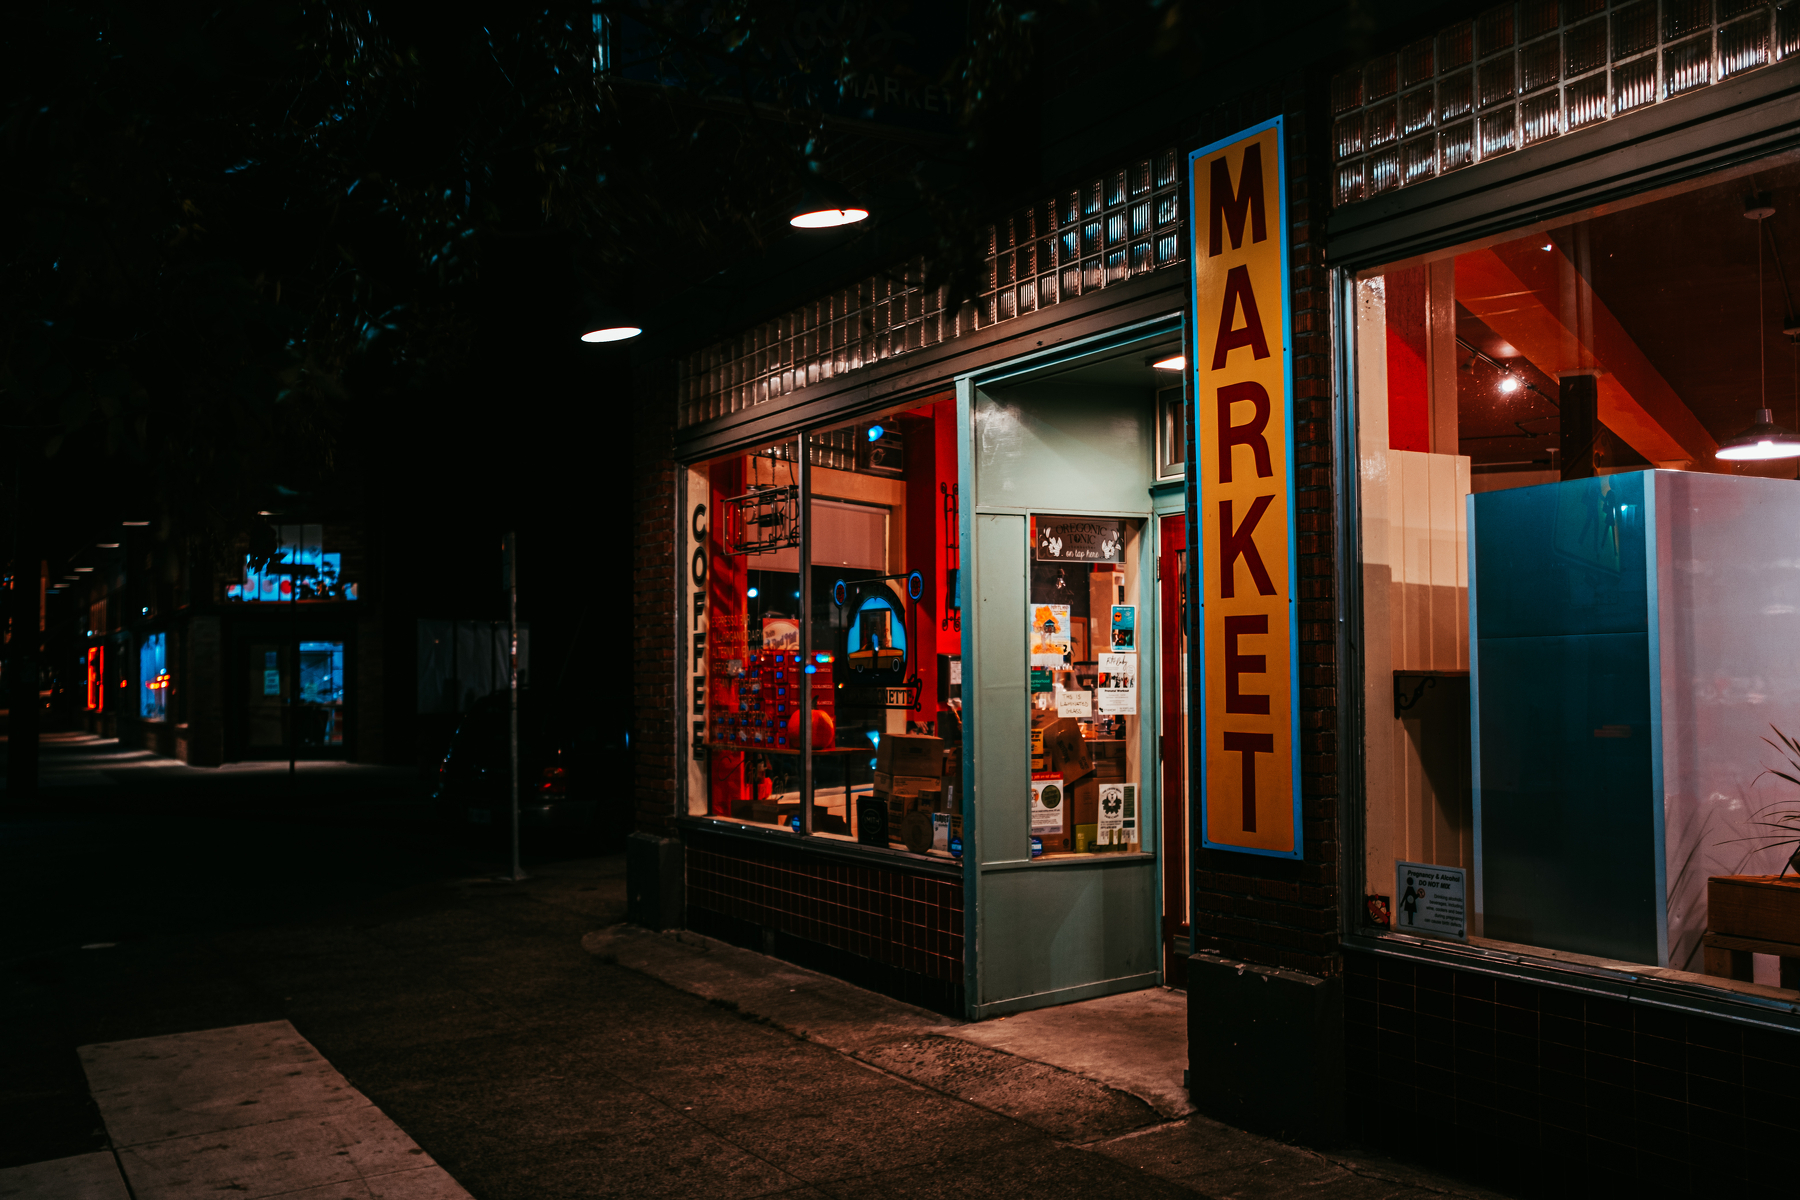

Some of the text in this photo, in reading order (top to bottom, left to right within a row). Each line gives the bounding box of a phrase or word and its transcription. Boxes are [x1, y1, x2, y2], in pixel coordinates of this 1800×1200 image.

[1208, 141, 1277, 833] MARKET
[1055, 522, 1107, 537] OREGONIC
[1066, 533, 1096, 545] TONIC
[1085, 549, 1099, 558] here
[691, 503, 708, 761] COFFEE
[1407, 870, 1434, 880] Pregnancy
[1440, 874, 1460, 882] Alcohol
